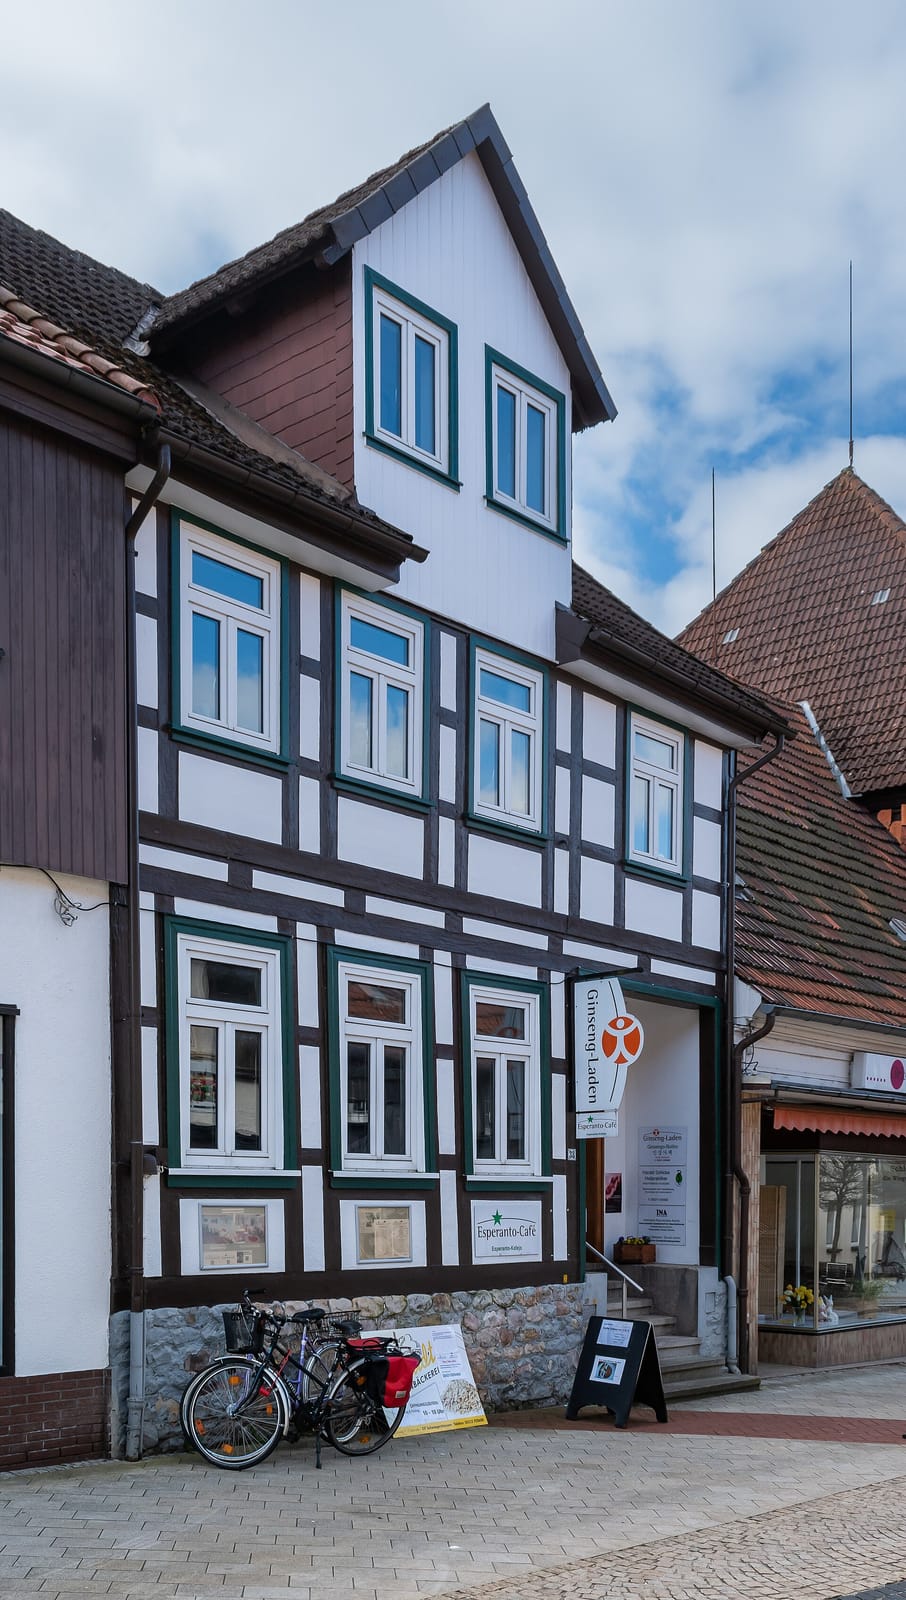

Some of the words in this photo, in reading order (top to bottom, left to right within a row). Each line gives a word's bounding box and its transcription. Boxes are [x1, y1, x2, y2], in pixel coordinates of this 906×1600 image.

[585, 989, 599, 1104] Ginseng-Laden
[642, 1134, 682, 1142] Ginseng-Laden
[477, 1224, 537, 1240] Esperanto-Café
[411, 1367, 440, 1389] BÄCKEREI
